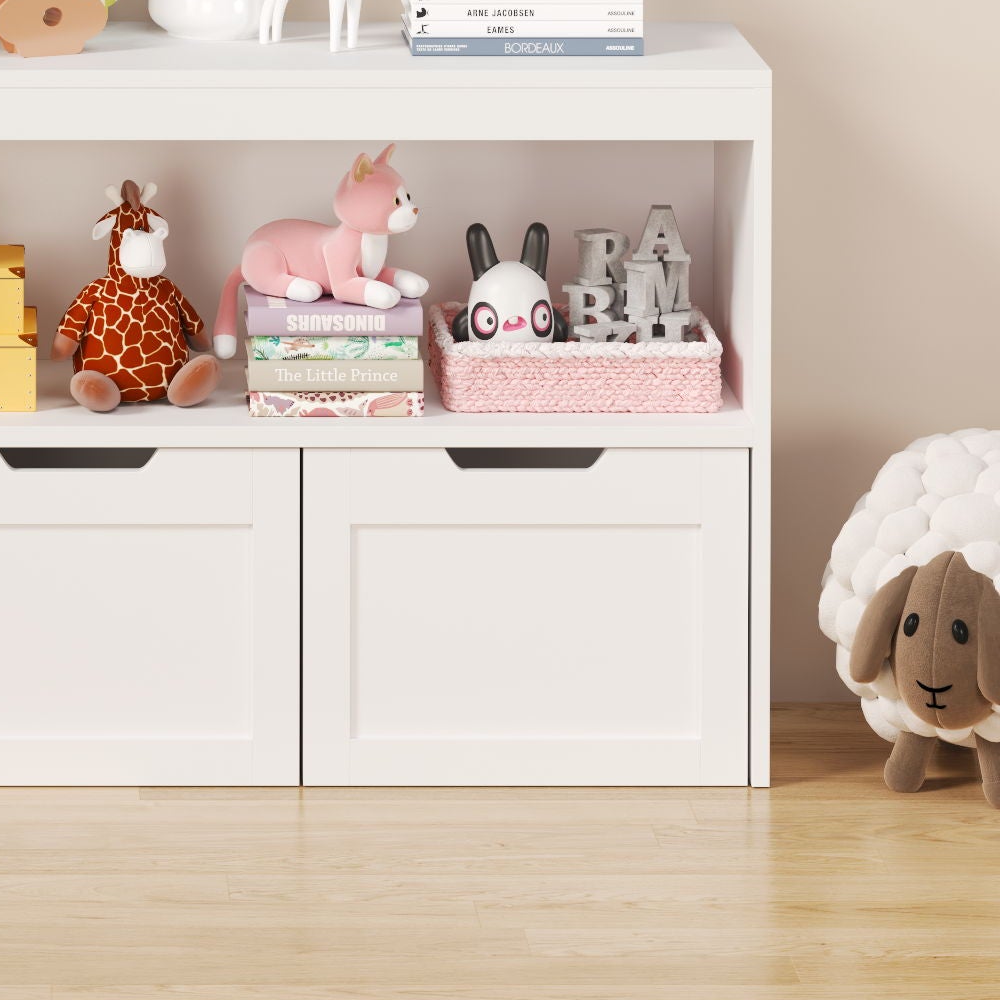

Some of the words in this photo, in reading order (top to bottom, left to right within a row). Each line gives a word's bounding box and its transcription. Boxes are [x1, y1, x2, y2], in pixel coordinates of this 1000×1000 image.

[467, 9, 489, 17] ARNE
[492, 9, 535, 17] JACOBSEN
[487, 26, 515, 34] EAMES
[504, 42, 565, 54] BORDEAUX
[286, 314, 386, 331] DINOSAURS
[275, 368, 301, 382] The
[306, 368, 347, 382] Little
[351, 368, 398, 382] Prince
